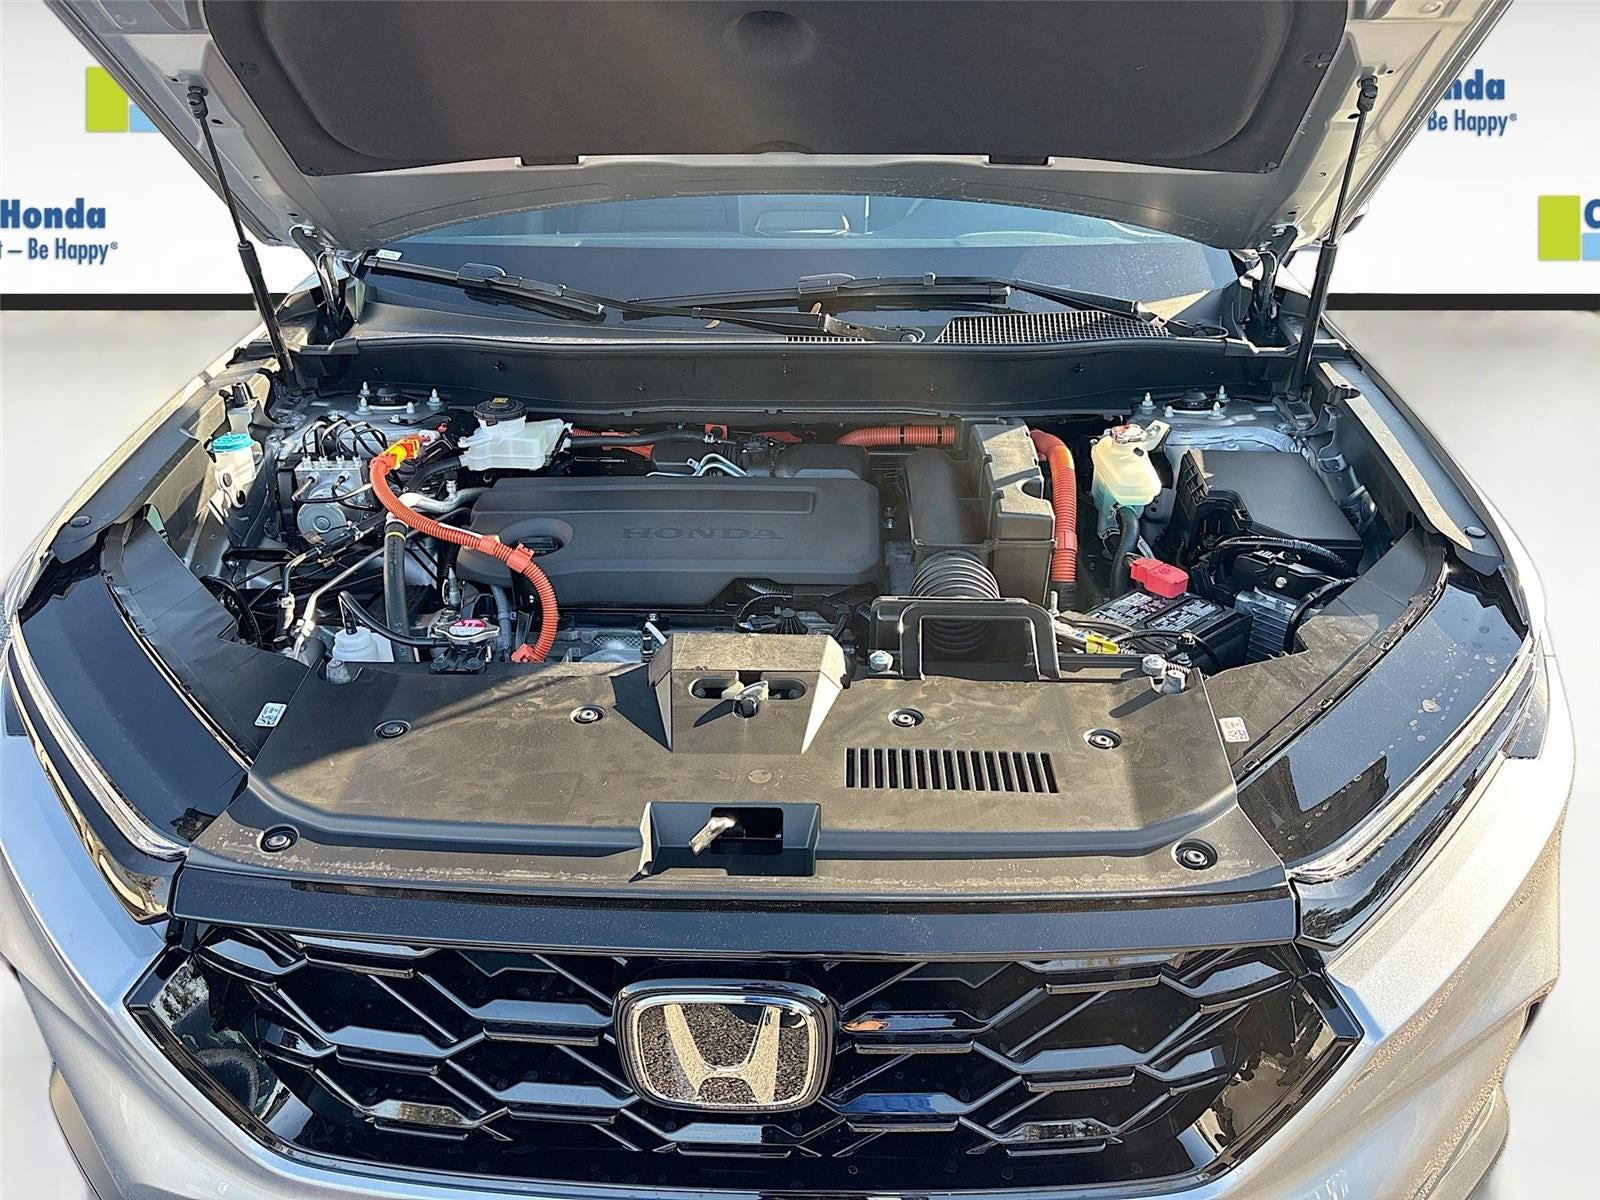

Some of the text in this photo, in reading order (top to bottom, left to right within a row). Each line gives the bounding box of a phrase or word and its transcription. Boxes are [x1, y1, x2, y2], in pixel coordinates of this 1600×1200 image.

[1443, 69, 1505, 100] nda
[1427, 109, 1448, 131] Be
[0, 197, 106, 229] Honda
[28, 238, 49, 260] Be
[617, 527, 784, 540] HONDA
